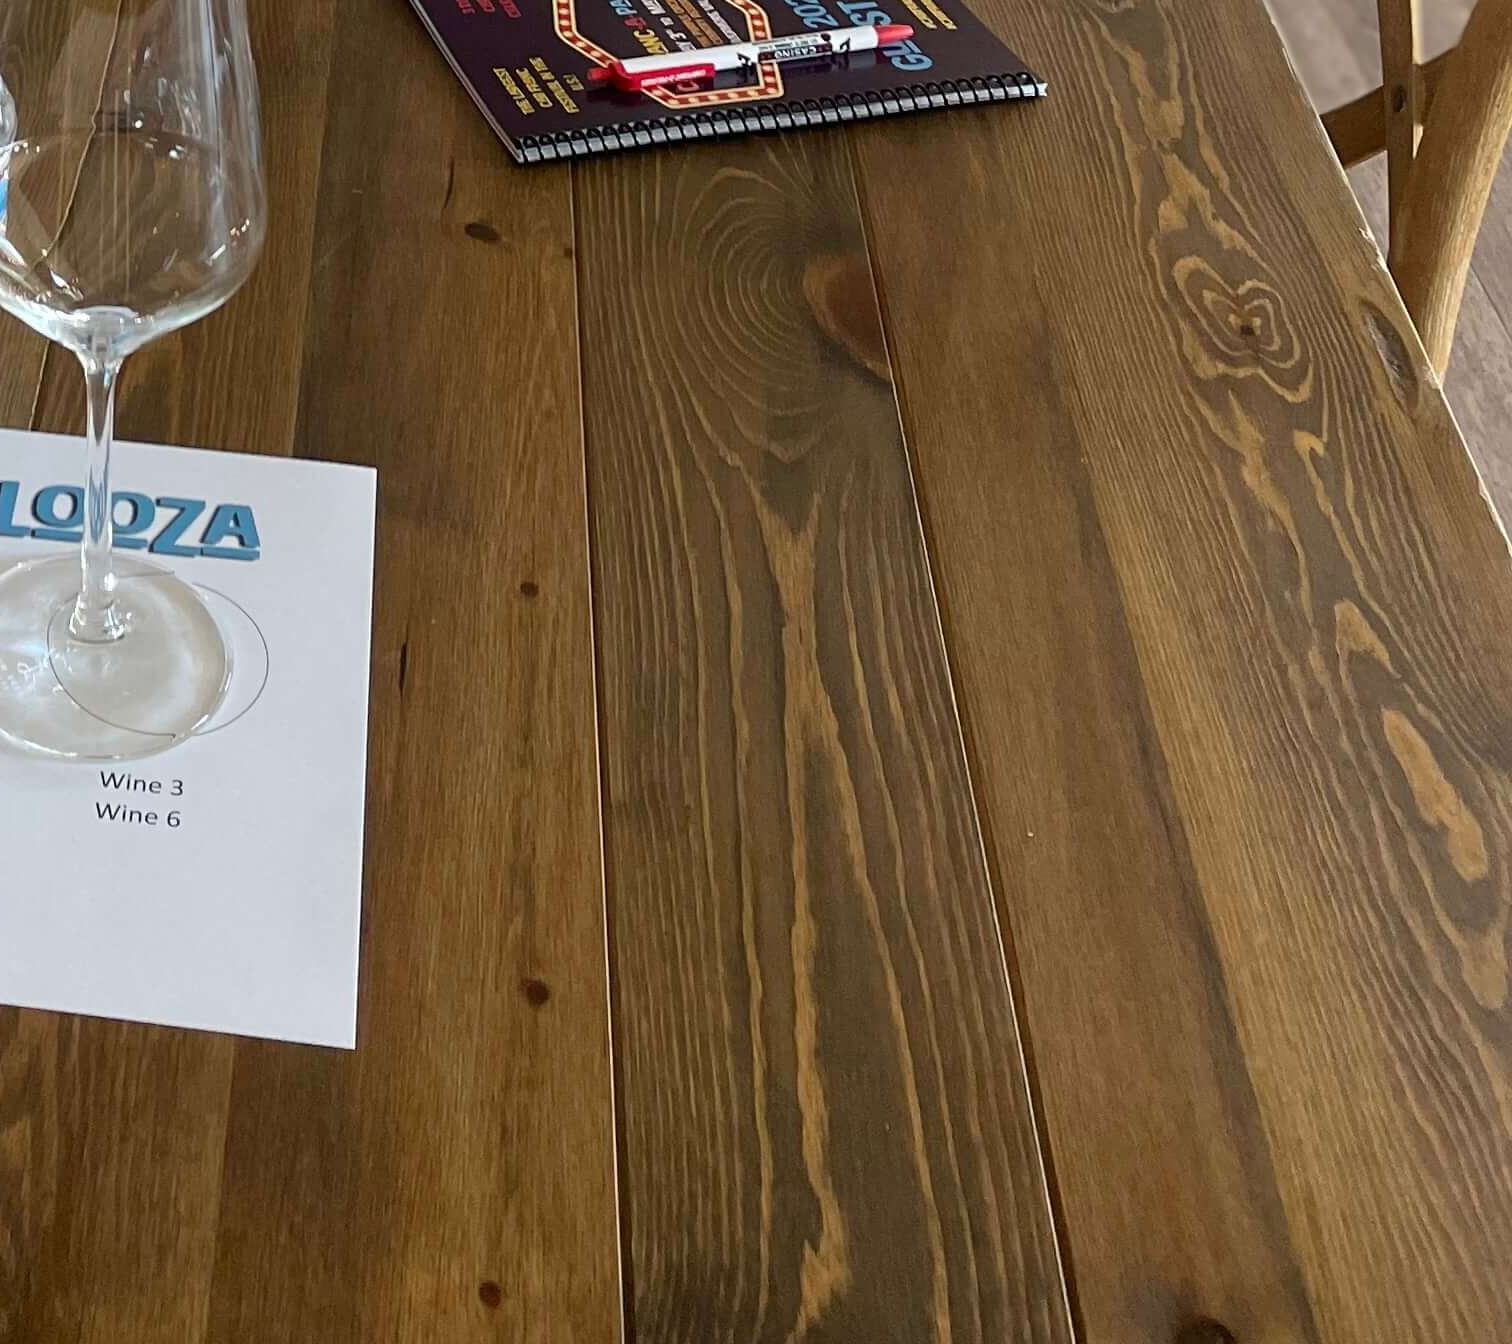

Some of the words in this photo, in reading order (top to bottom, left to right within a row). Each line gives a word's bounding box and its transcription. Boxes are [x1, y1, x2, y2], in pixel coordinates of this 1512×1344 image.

[836, 0, 934, 72] GUST
[99, 770, 163, 796] Wine
[169, 779, 184, 797] 3
[95, 801, 159, 827] Wine
[166, 809, 182, 829] 6
